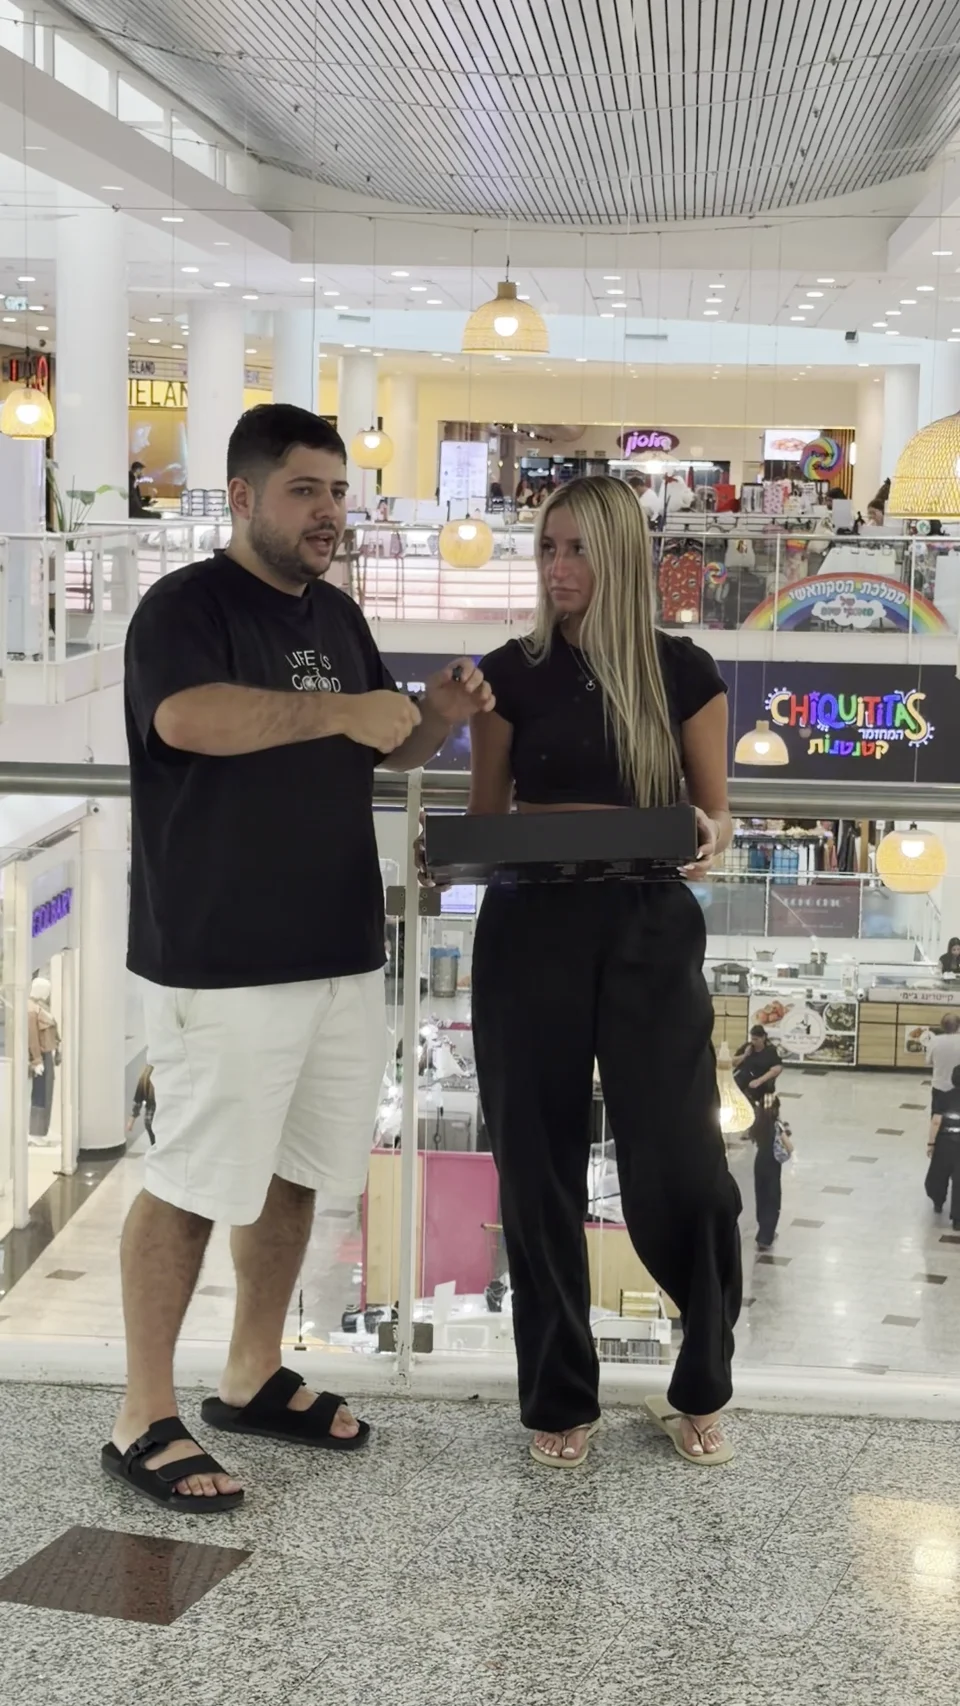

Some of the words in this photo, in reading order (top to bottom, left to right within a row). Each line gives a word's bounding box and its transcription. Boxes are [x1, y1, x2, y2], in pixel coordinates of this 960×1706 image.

[789, 580, 854, 601] הסקוואשי
[860, 582, 906, 605] ממלכת
[284, 650, 316, 669] LIFE
[319, 652, 332, 671] IS
[858, 728, 904, 740] המחזמר
